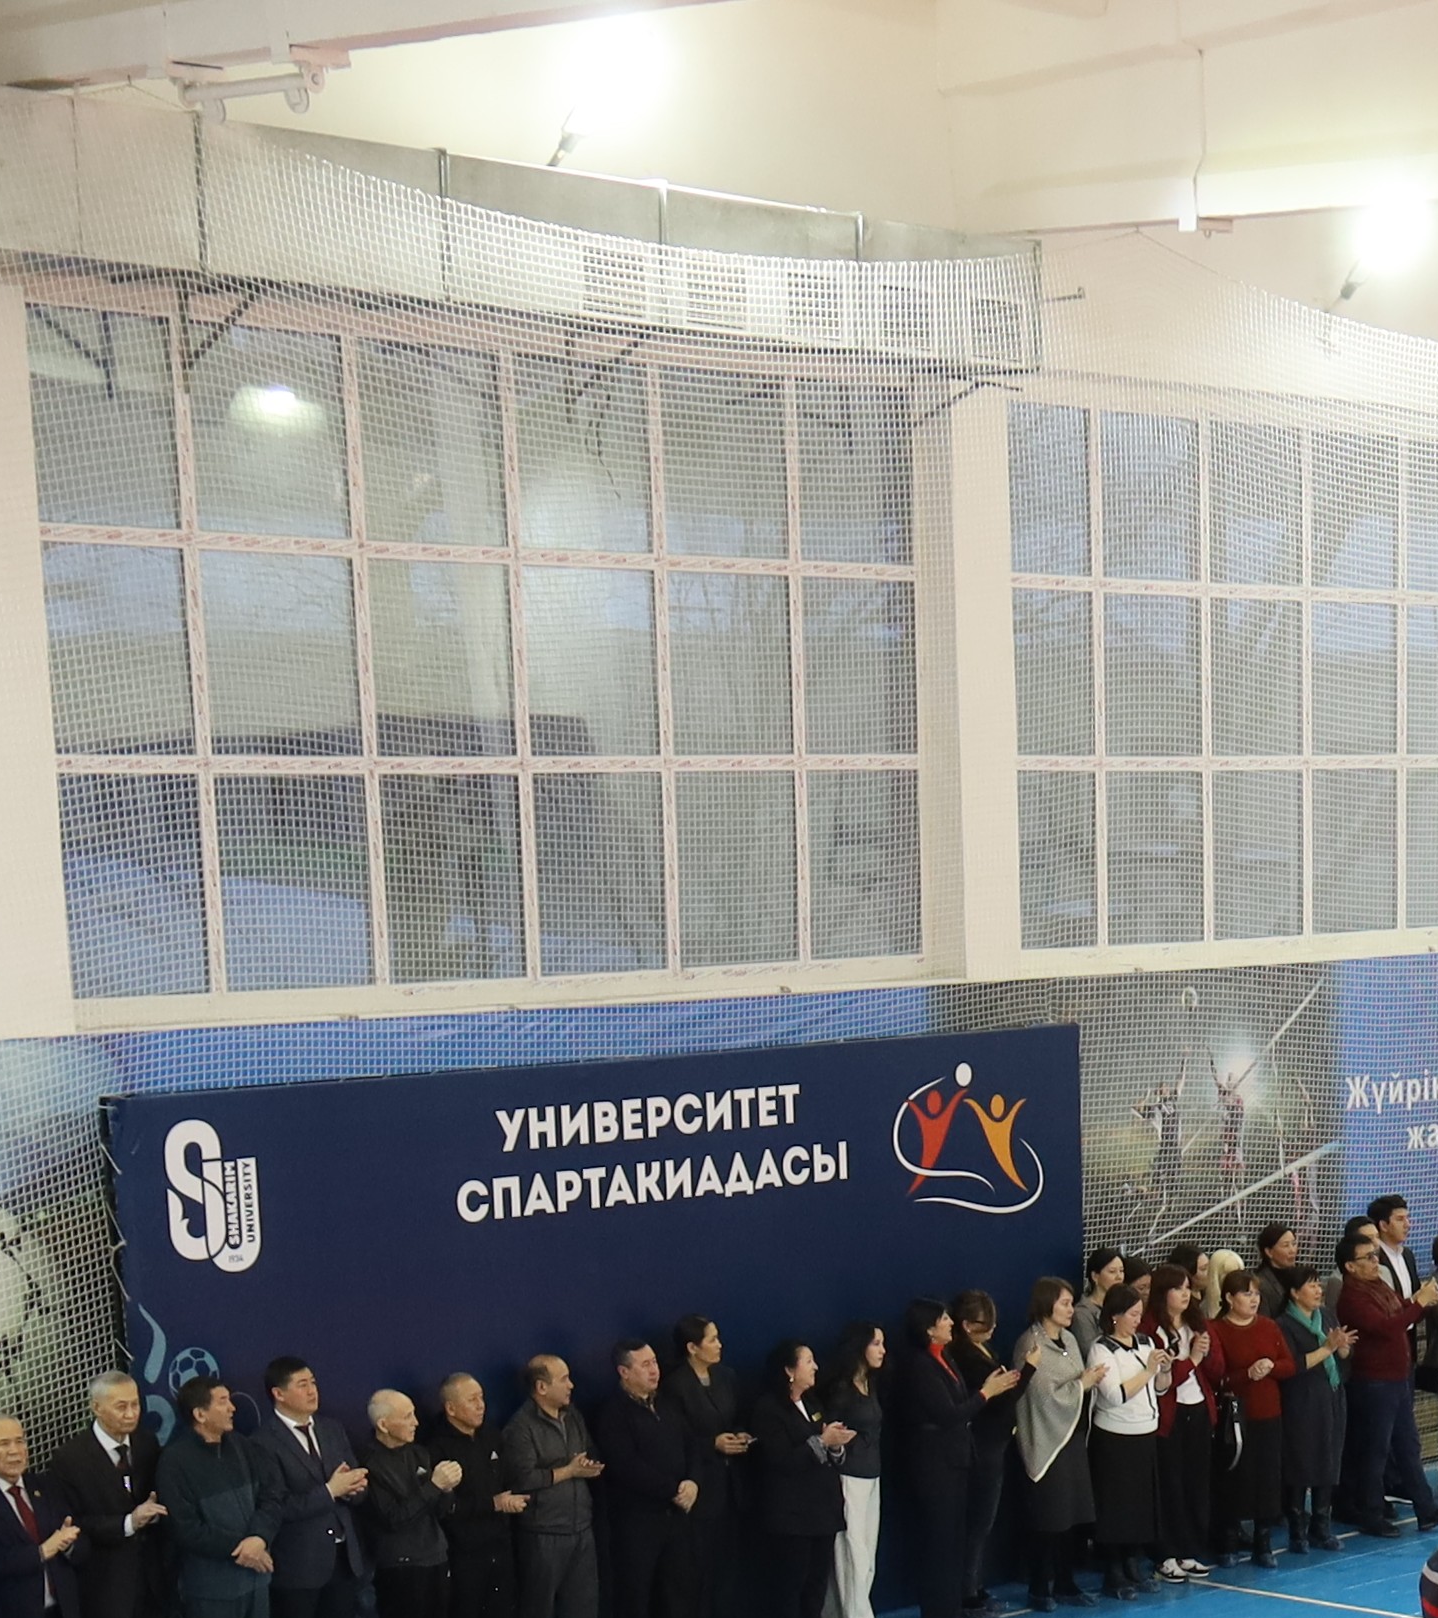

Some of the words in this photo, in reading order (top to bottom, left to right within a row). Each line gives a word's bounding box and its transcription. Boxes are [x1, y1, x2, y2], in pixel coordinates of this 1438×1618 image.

[495, 1083, 801, 1152] УНИВЕРСИТЕТ
[223, 1160, 241, 1246] SHAKARIM
[242, 1161, 257, 1243] UNIVERSITY
[456, 1140, 849, 1224] СПАРТАКИАДАСЫ
